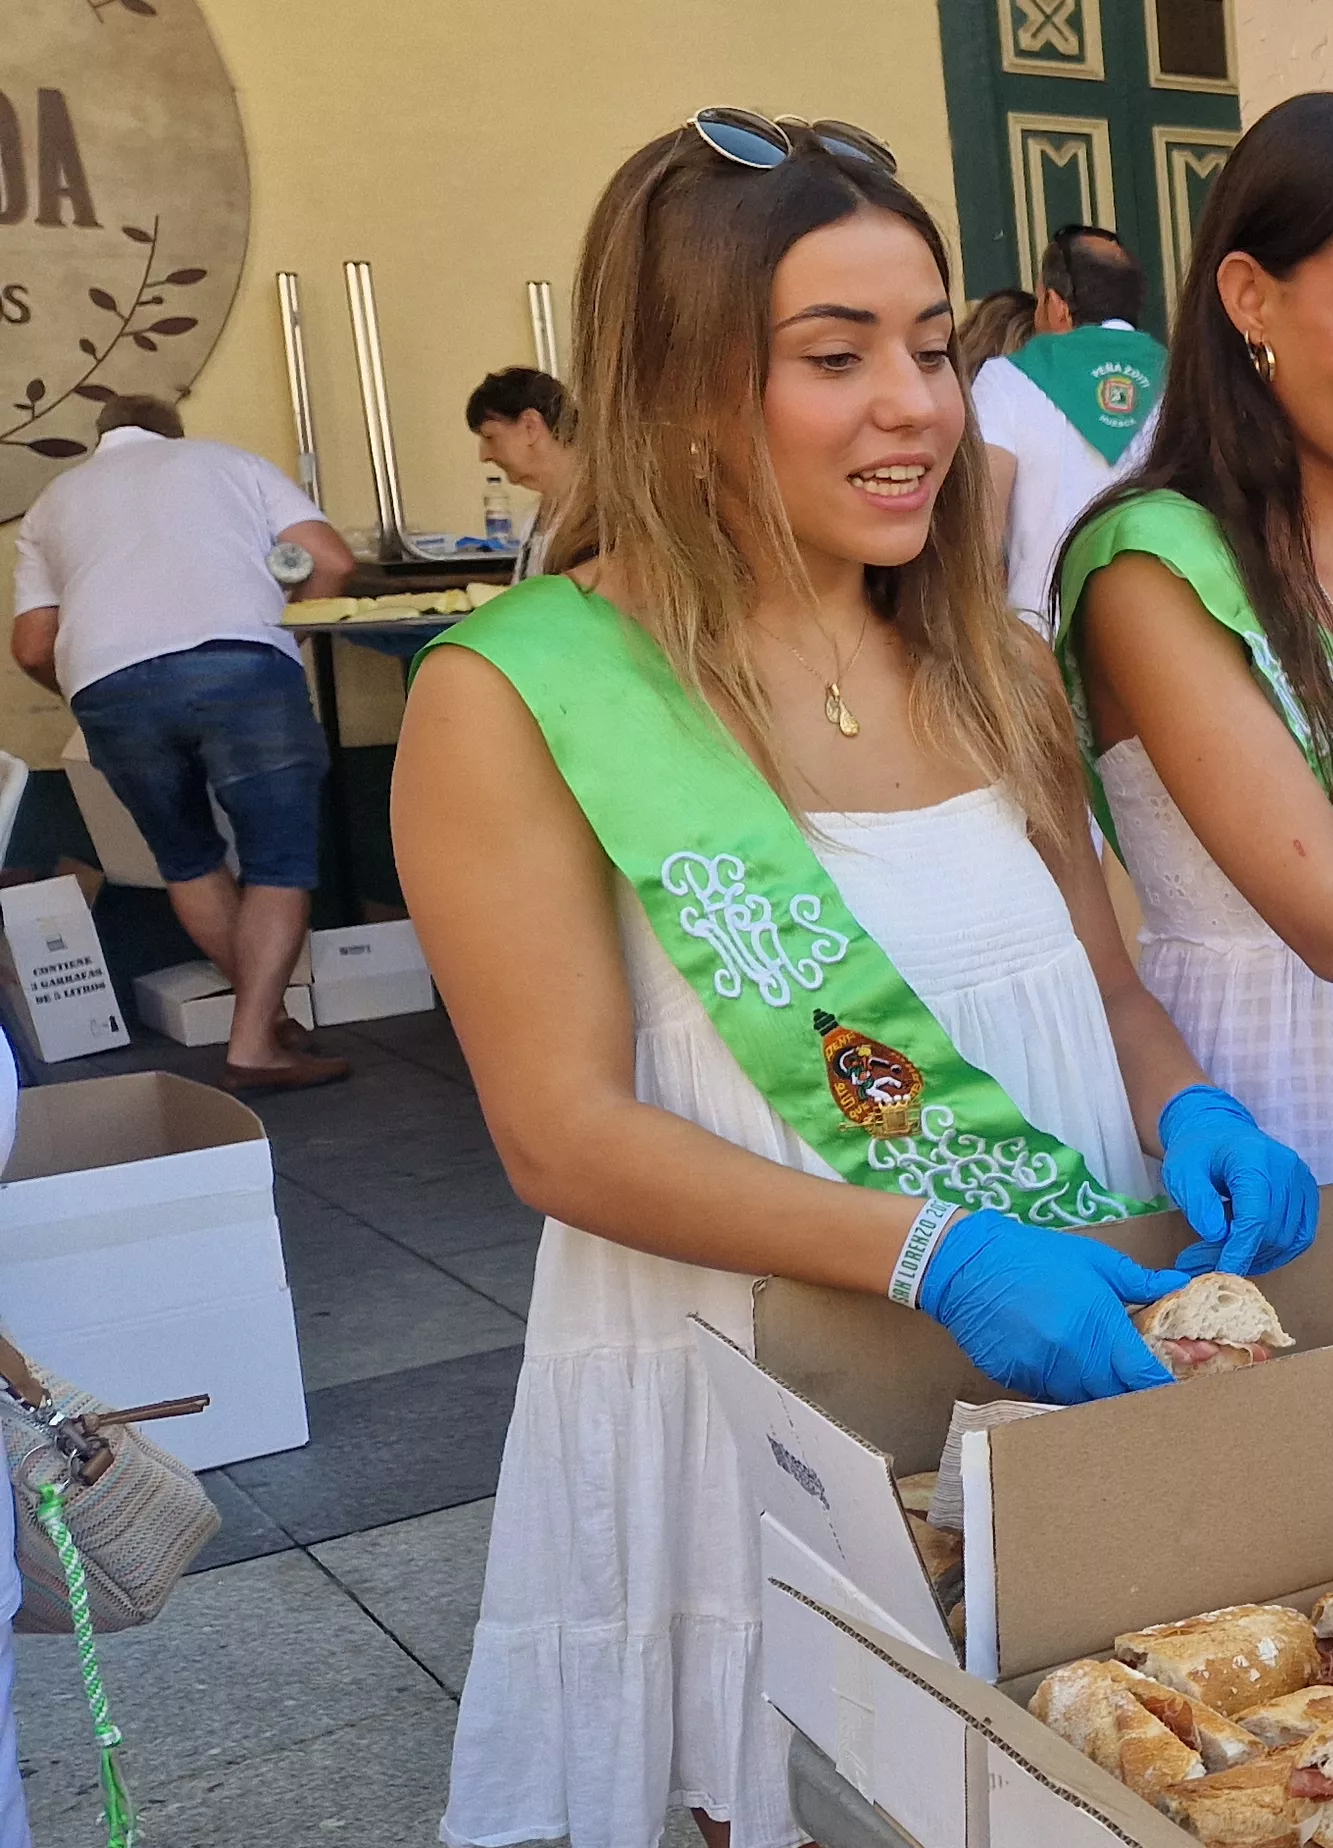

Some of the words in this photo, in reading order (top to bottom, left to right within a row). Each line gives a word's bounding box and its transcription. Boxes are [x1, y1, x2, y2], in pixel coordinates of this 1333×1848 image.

[33, 956, 93, 977] CONTIENE
[898, 1219, 937, 1279] LORENZO
[892, 1279, 913, 1303] SAN
